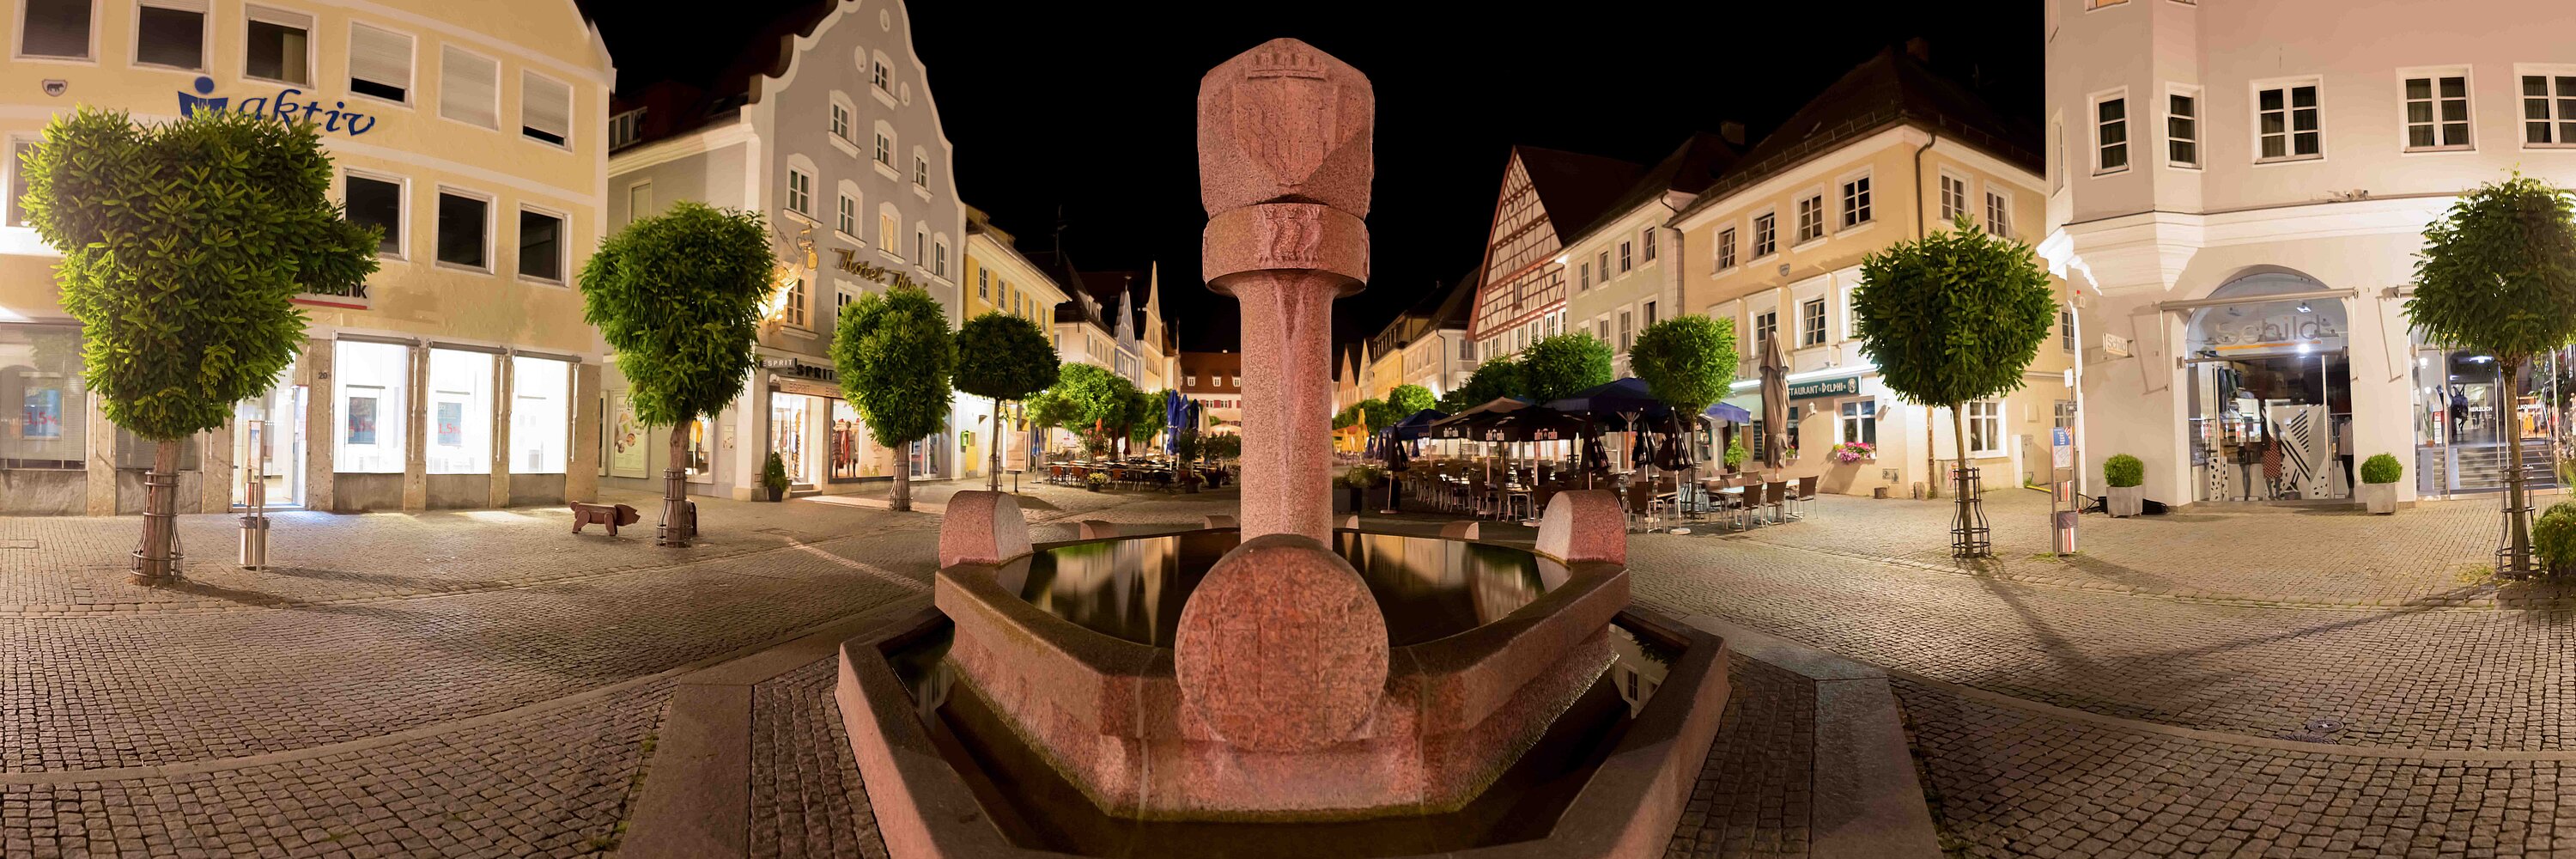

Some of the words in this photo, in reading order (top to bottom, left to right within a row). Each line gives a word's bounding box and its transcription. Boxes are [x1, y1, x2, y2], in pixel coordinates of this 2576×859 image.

[239, 88, 376, 137] aktiv
[829, 247, 886, 283] Hotel
[2216, 314, 2322, 344] Schild
[789, 383, 811, 393] ESPRIT
